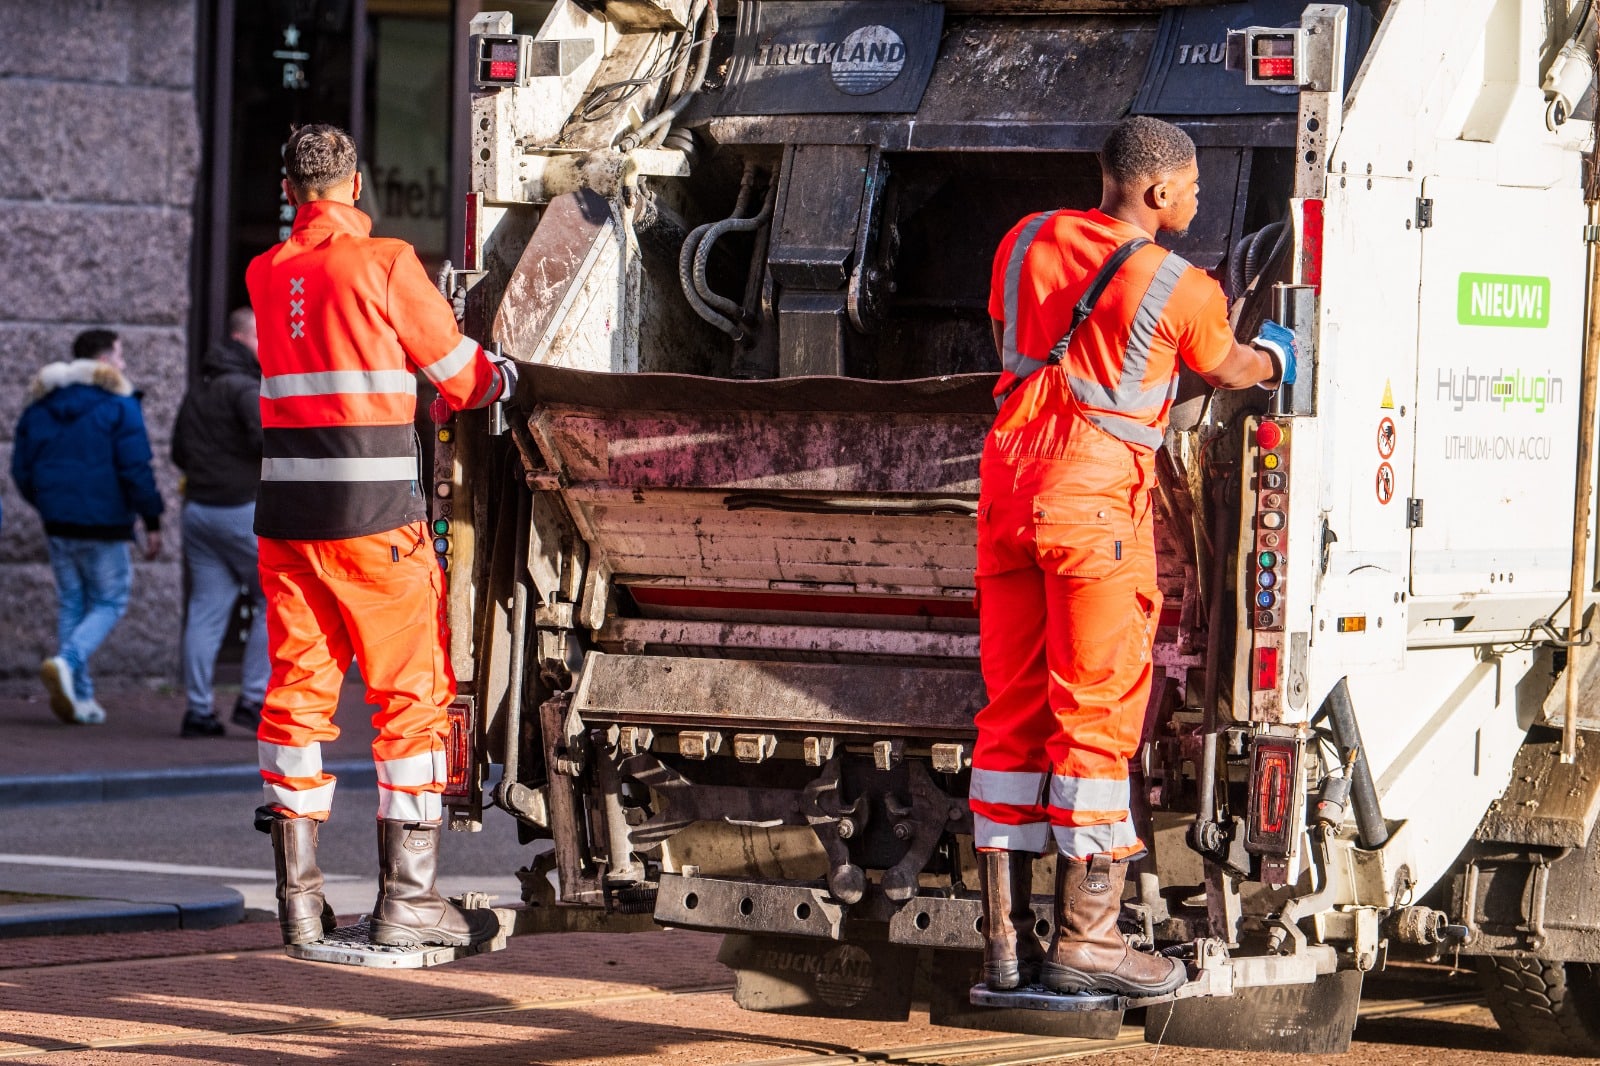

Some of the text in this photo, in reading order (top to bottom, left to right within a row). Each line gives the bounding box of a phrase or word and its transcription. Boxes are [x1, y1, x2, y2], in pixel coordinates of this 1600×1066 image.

[756, 42, 905, 66] TRUCKLAND
[1178, 42, 1227, 65] TRU
[1471, 282, 1543, 320] NIEUW!
[1445, 435, 1552, 461] LITHIUM-ION ACCU
